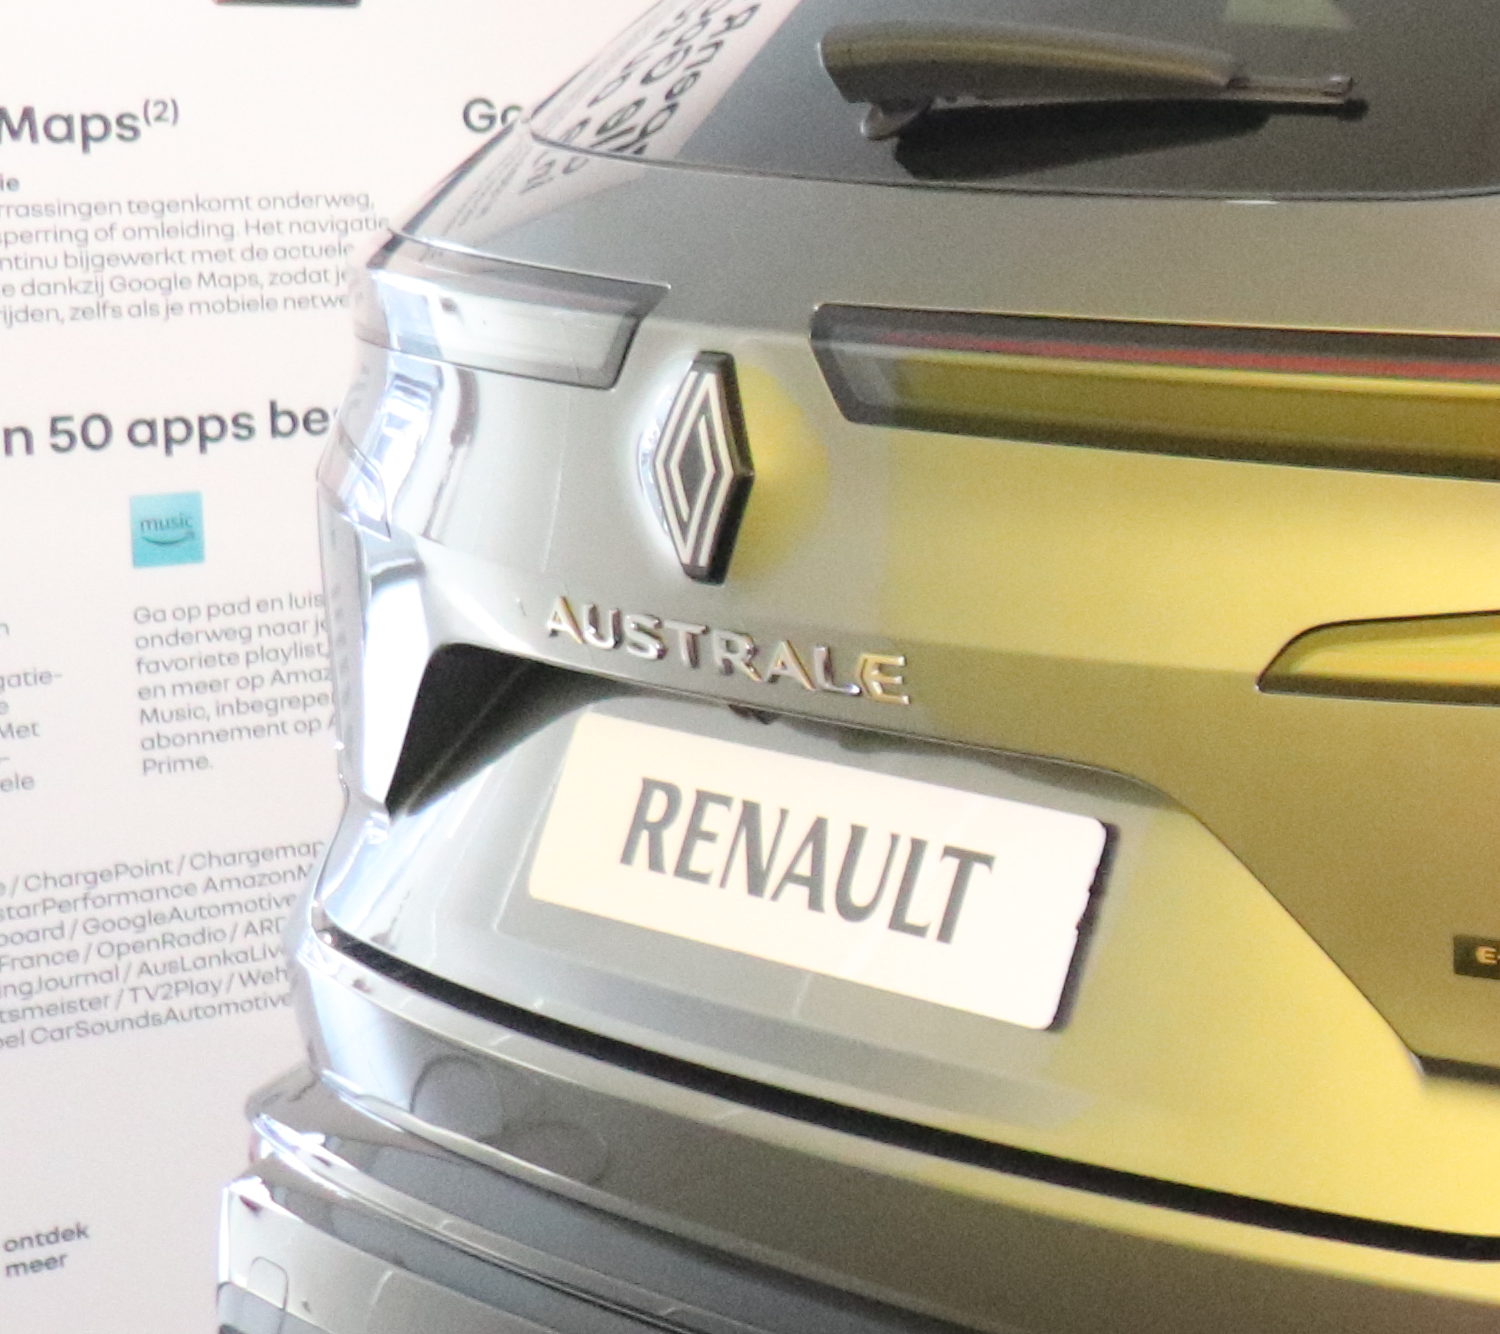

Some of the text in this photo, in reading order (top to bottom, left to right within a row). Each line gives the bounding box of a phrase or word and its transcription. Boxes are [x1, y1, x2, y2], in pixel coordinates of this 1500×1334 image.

[128, 193, 252, 219] tegenkomt
[258, 190, 375, 212] onderweg,
[0, 224, 89, 249] perring
[95, 222, 116, 241] of
[245, 218, 285, 236] Het
[64, 247, 187, 273] bijgewerkt
[192, 245, 235, 263] met
[241, 244, 268, 262] de
[21, 276, 104, 299] dankzij
[110, 272, 192, 296] Google
[198, 270, 264, 292] Maps,
[269, 268, 330, 286] zodat
[70, 299, 122, 321] zelfs
[128, 298, 160, 318] als
[165, 298, 183, 322] je
[190, 295, 278, 315] mobiele
[50, 413, 113, 454] 50
[127, 410, 256, 457] apps
[270, 399, 338, 439] be
[140, 512, 194, 533] music
[133, 606, 166, 624] Ga
[172, 604, 202, 624] op
[207, 597, 250, 621] pad
[256, 597, 284, 613] en
[135, 625, 252, 650] onderweg
[258, 618, 310, 638] naar
[136, 651, 240, 675] favoriete
[138, 684, 166, 701] en
[172, 678, 230, 697] meer
[236, 674, 264, 693] op
[139, 704, 210, 726] Music,
[140, 720, 288, 751] abonnement
[294, 718, 321, 737] op
[142, 755, 214, 776] Prime.
[619, 776, 996, 944] RENAULT
[24, 859, 174, 893] ChargePoint
[97, 926, 227, 961] OpenRadio
[137, 944, 284, 979] AusLankaLiv
[129, 977, 222, 1004] TV2Play
[2, 1221, 91, 1252] ontdek
[4, 1252, 68, 1278] meer
